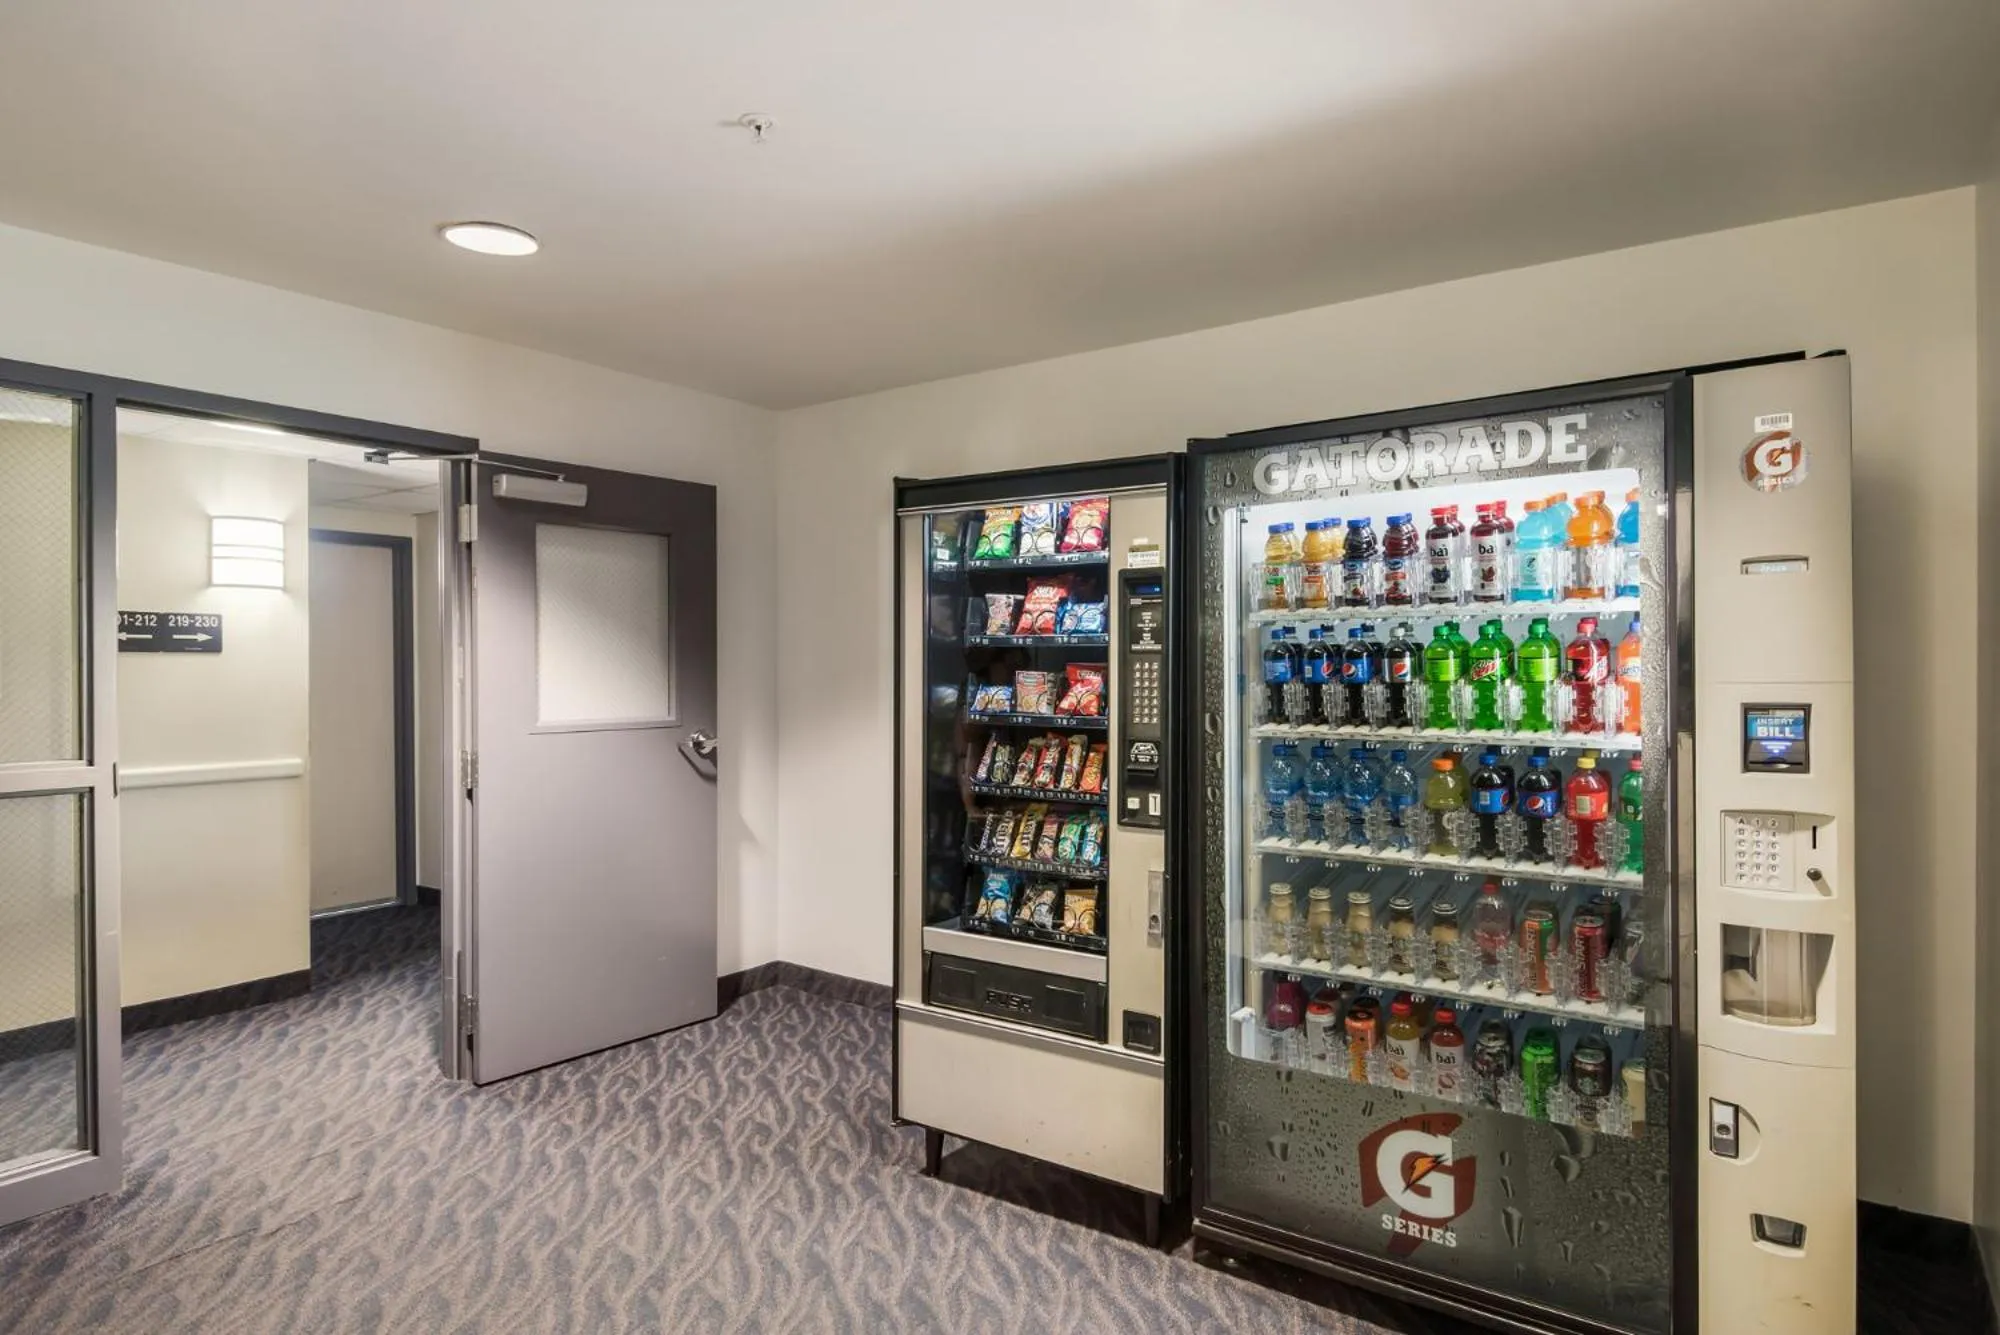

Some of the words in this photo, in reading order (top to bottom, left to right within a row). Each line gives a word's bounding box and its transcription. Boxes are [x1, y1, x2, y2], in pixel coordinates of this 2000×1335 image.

[1253, 413, 1587, 495] GATORADE
[168, 614, 218, 628] 219-230
[1757, 717, 1794, 726] INSERT
[1757, 726, 1795, 737] BILL
[1376, 1130, 1455, 1219] G
[1381, 1213, 1458, 1248] SERIES
